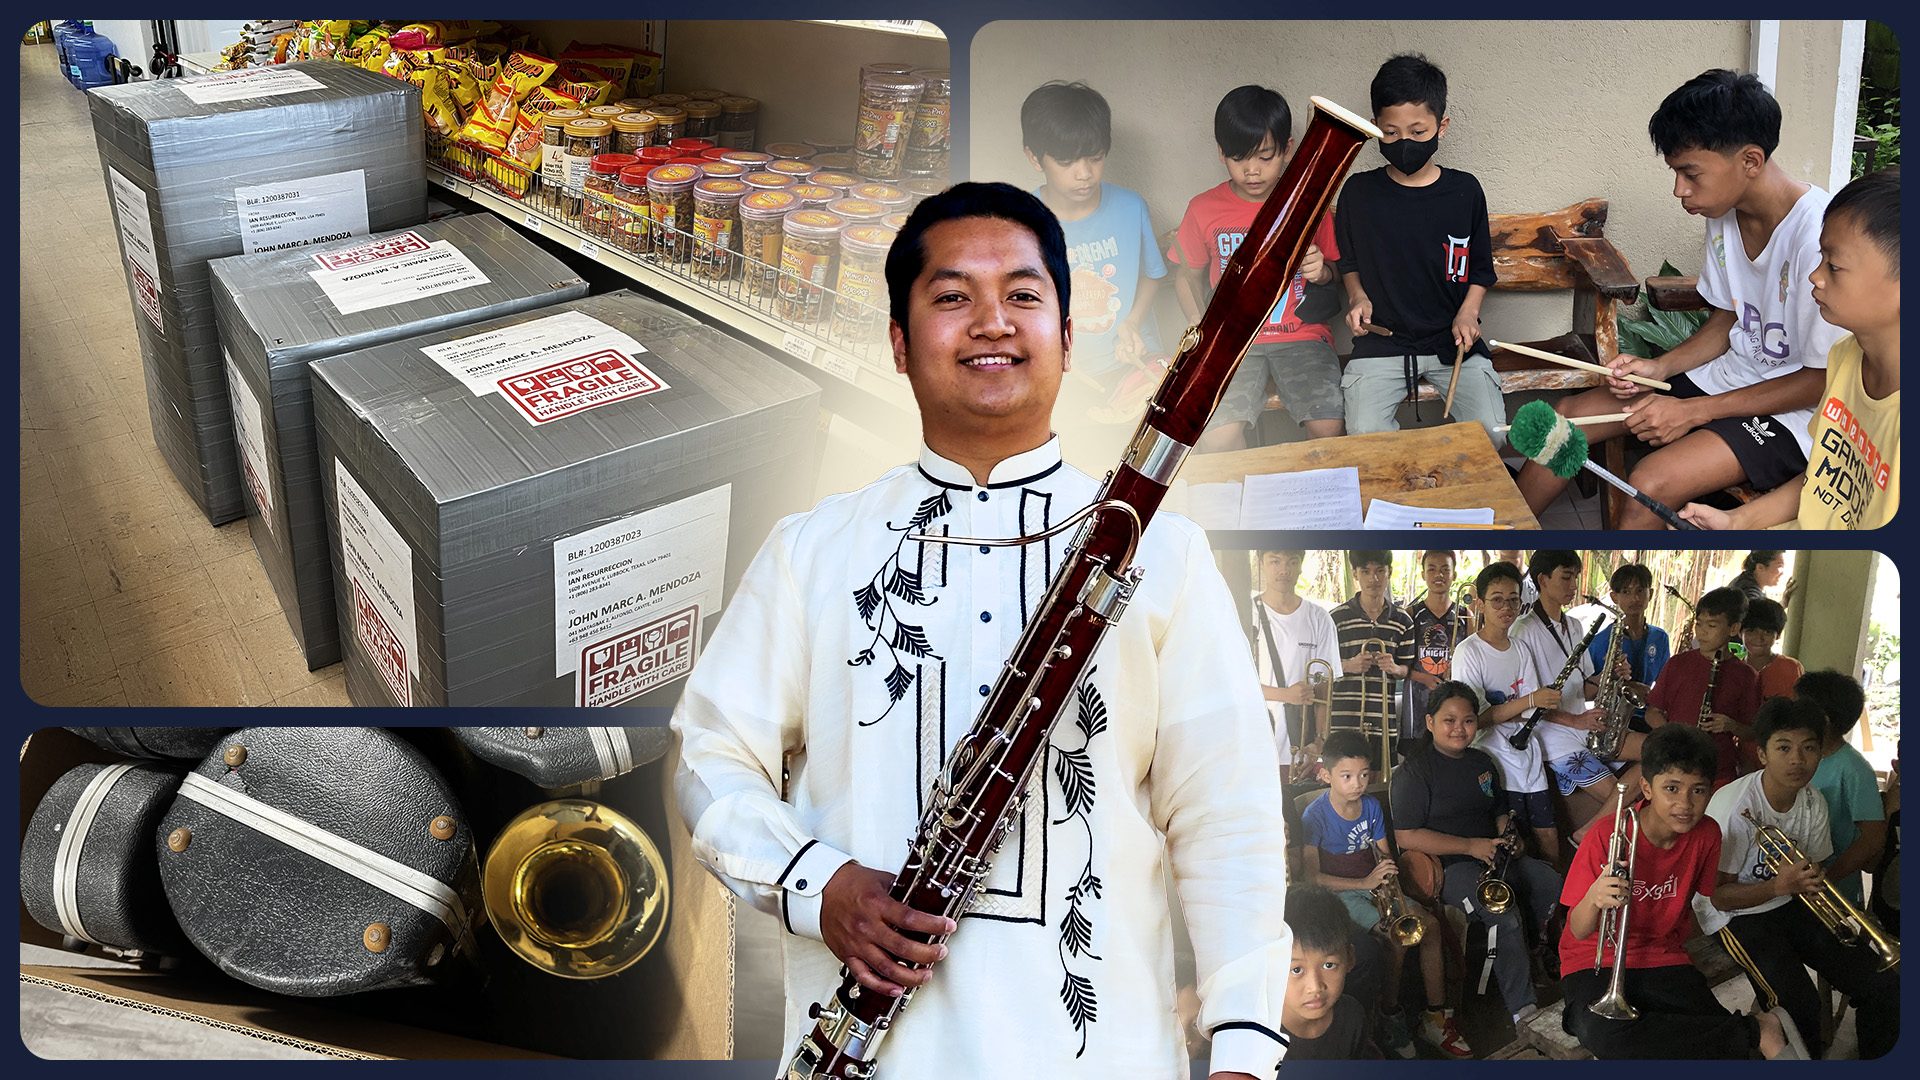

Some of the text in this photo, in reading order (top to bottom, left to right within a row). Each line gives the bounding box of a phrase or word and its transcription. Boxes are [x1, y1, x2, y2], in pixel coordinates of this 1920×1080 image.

[312, 231, 353, 245] MENDOZA
[1217, 232, 1249, 257] GR
[465, 362, 495, 374] JOHN
[495, 352, 530, 366] MARC
[530, 349, 542, 357] A.
[542, 333, 596, 352] MENDOZA
[525, 369, 639, 408] FRAGILE
[538, 380, 649, 417] HANDLE WITH CARE
[1741, 421, 1765, 445] adidas
[1820, 427, 1875, 506] GAMING
[1813, 484, 1843, 511] NOT
[567, 529, 642, 562] BL#: 1200387023
[568, 558, 633, 586] IAN RESURRECCION
[581, 579, 601, 589] AVENUE
[646, 556, 657, 565] USA
[567, 570, 702, 629] JOHN MARC A. MENDOZA
[588, 639, 690, 696] FRAGILE
[588, 660, 688, 708] HANDLE WITH CARE
